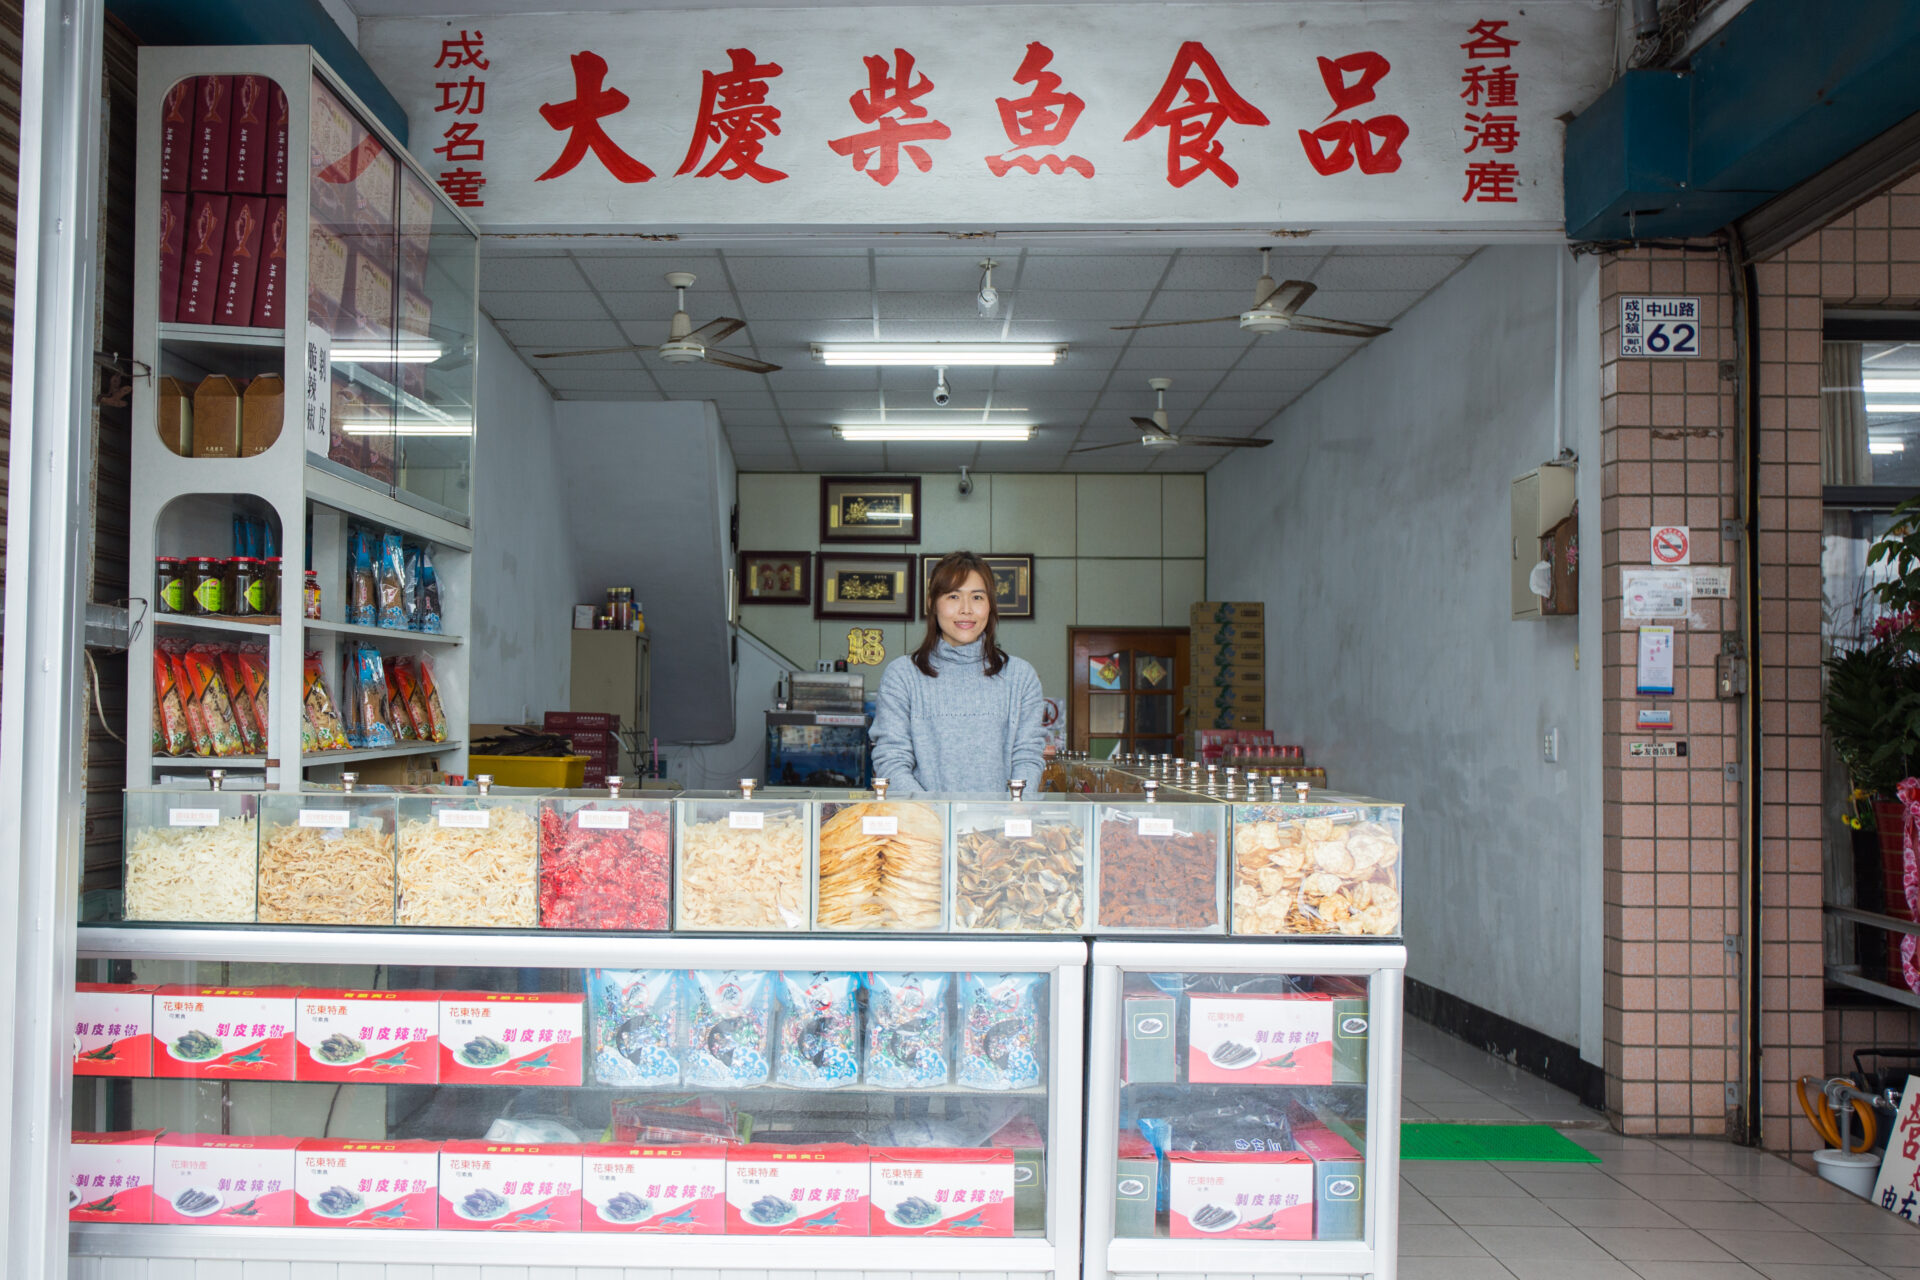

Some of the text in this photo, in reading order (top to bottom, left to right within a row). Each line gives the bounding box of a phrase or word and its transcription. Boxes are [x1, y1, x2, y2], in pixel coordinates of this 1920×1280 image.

[535, 41, 1409, 188] 大慶柴魚食品
[1624, 300, 1640, 334] 成功鎮
[1646, 302, 1694, 317] 中山路
[1647, 324, 1695, 352] 62
[216, 1023, 285, 1038] 剝皮辣椒
[358, 1026, 428, 1042] 剝皮辣椒
[502, 1028, 573, 1043] 剝皮辣椒
[1255, 1030, 1319, 1044] 剝皮辣椒
[76, 1173, 140, 1188] 剝皮辣椒
[217, 1178, 281, 1192] 剝皮辣椒
[357, 1178, 427, 1193] 剝皮辣椒
[502, 1181, 572, 1196] 剝皮辣椒
[645, 1184, 715, 1199] 剝皮辣椒
[790, 1187, 859, 1202] 剝皮辣椒
[934, 1189, 1004, 1203] 剝皮辣椒
[1234, 1194, 1299, 1207] 剝皮辣椒
